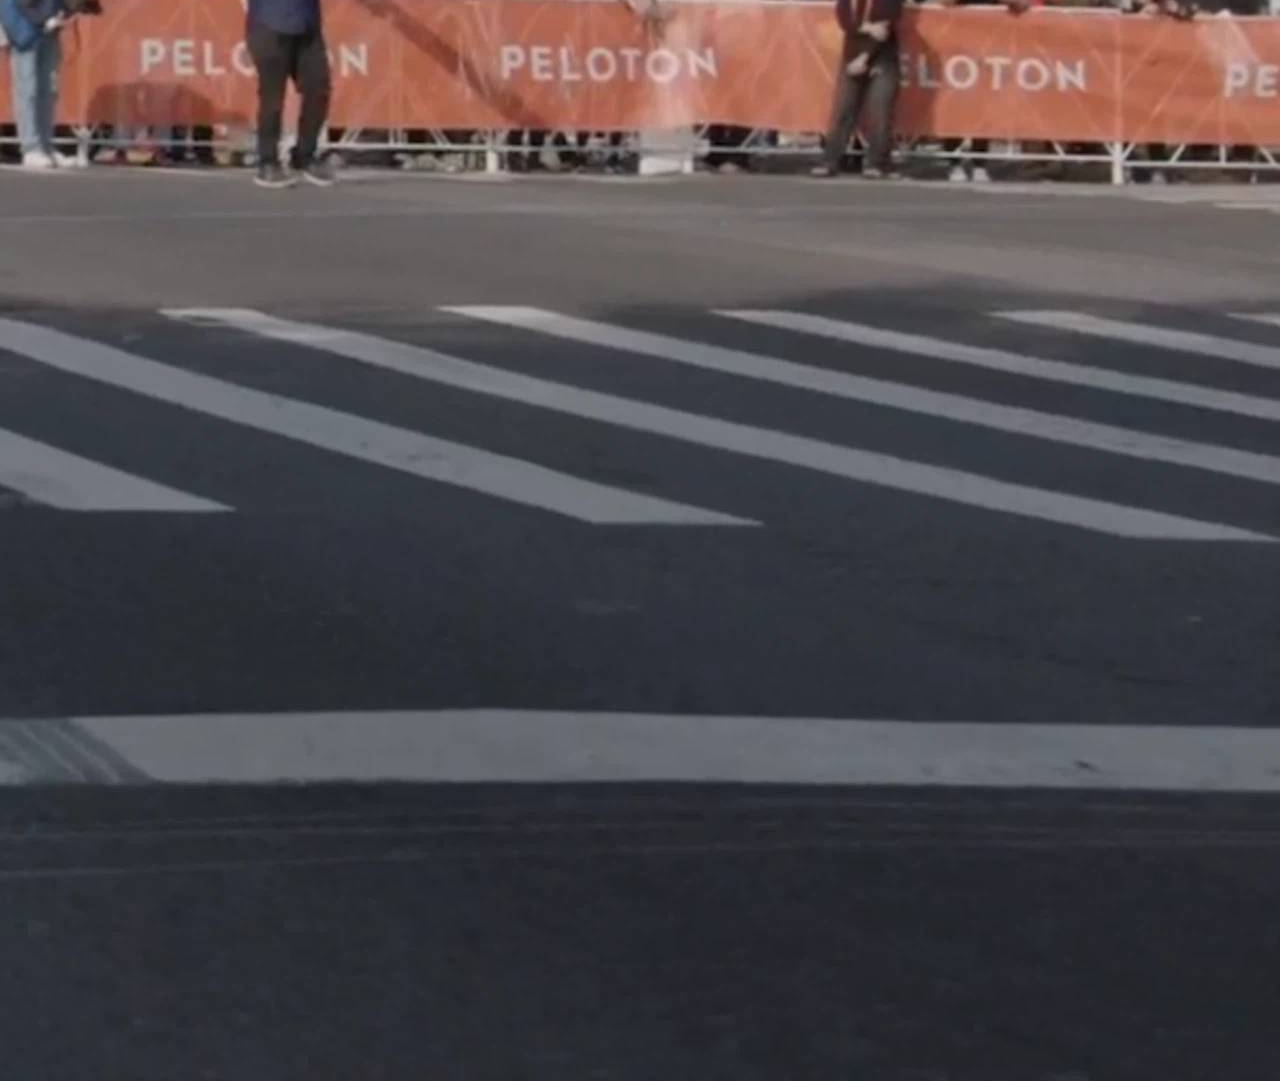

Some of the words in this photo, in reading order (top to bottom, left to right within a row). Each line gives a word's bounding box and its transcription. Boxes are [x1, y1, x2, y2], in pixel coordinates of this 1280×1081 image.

[140, 38, 370, 78] PELON
[501, 44, 718, 84] PELOTON
[898, 53, 1087, 91] ELOTON
